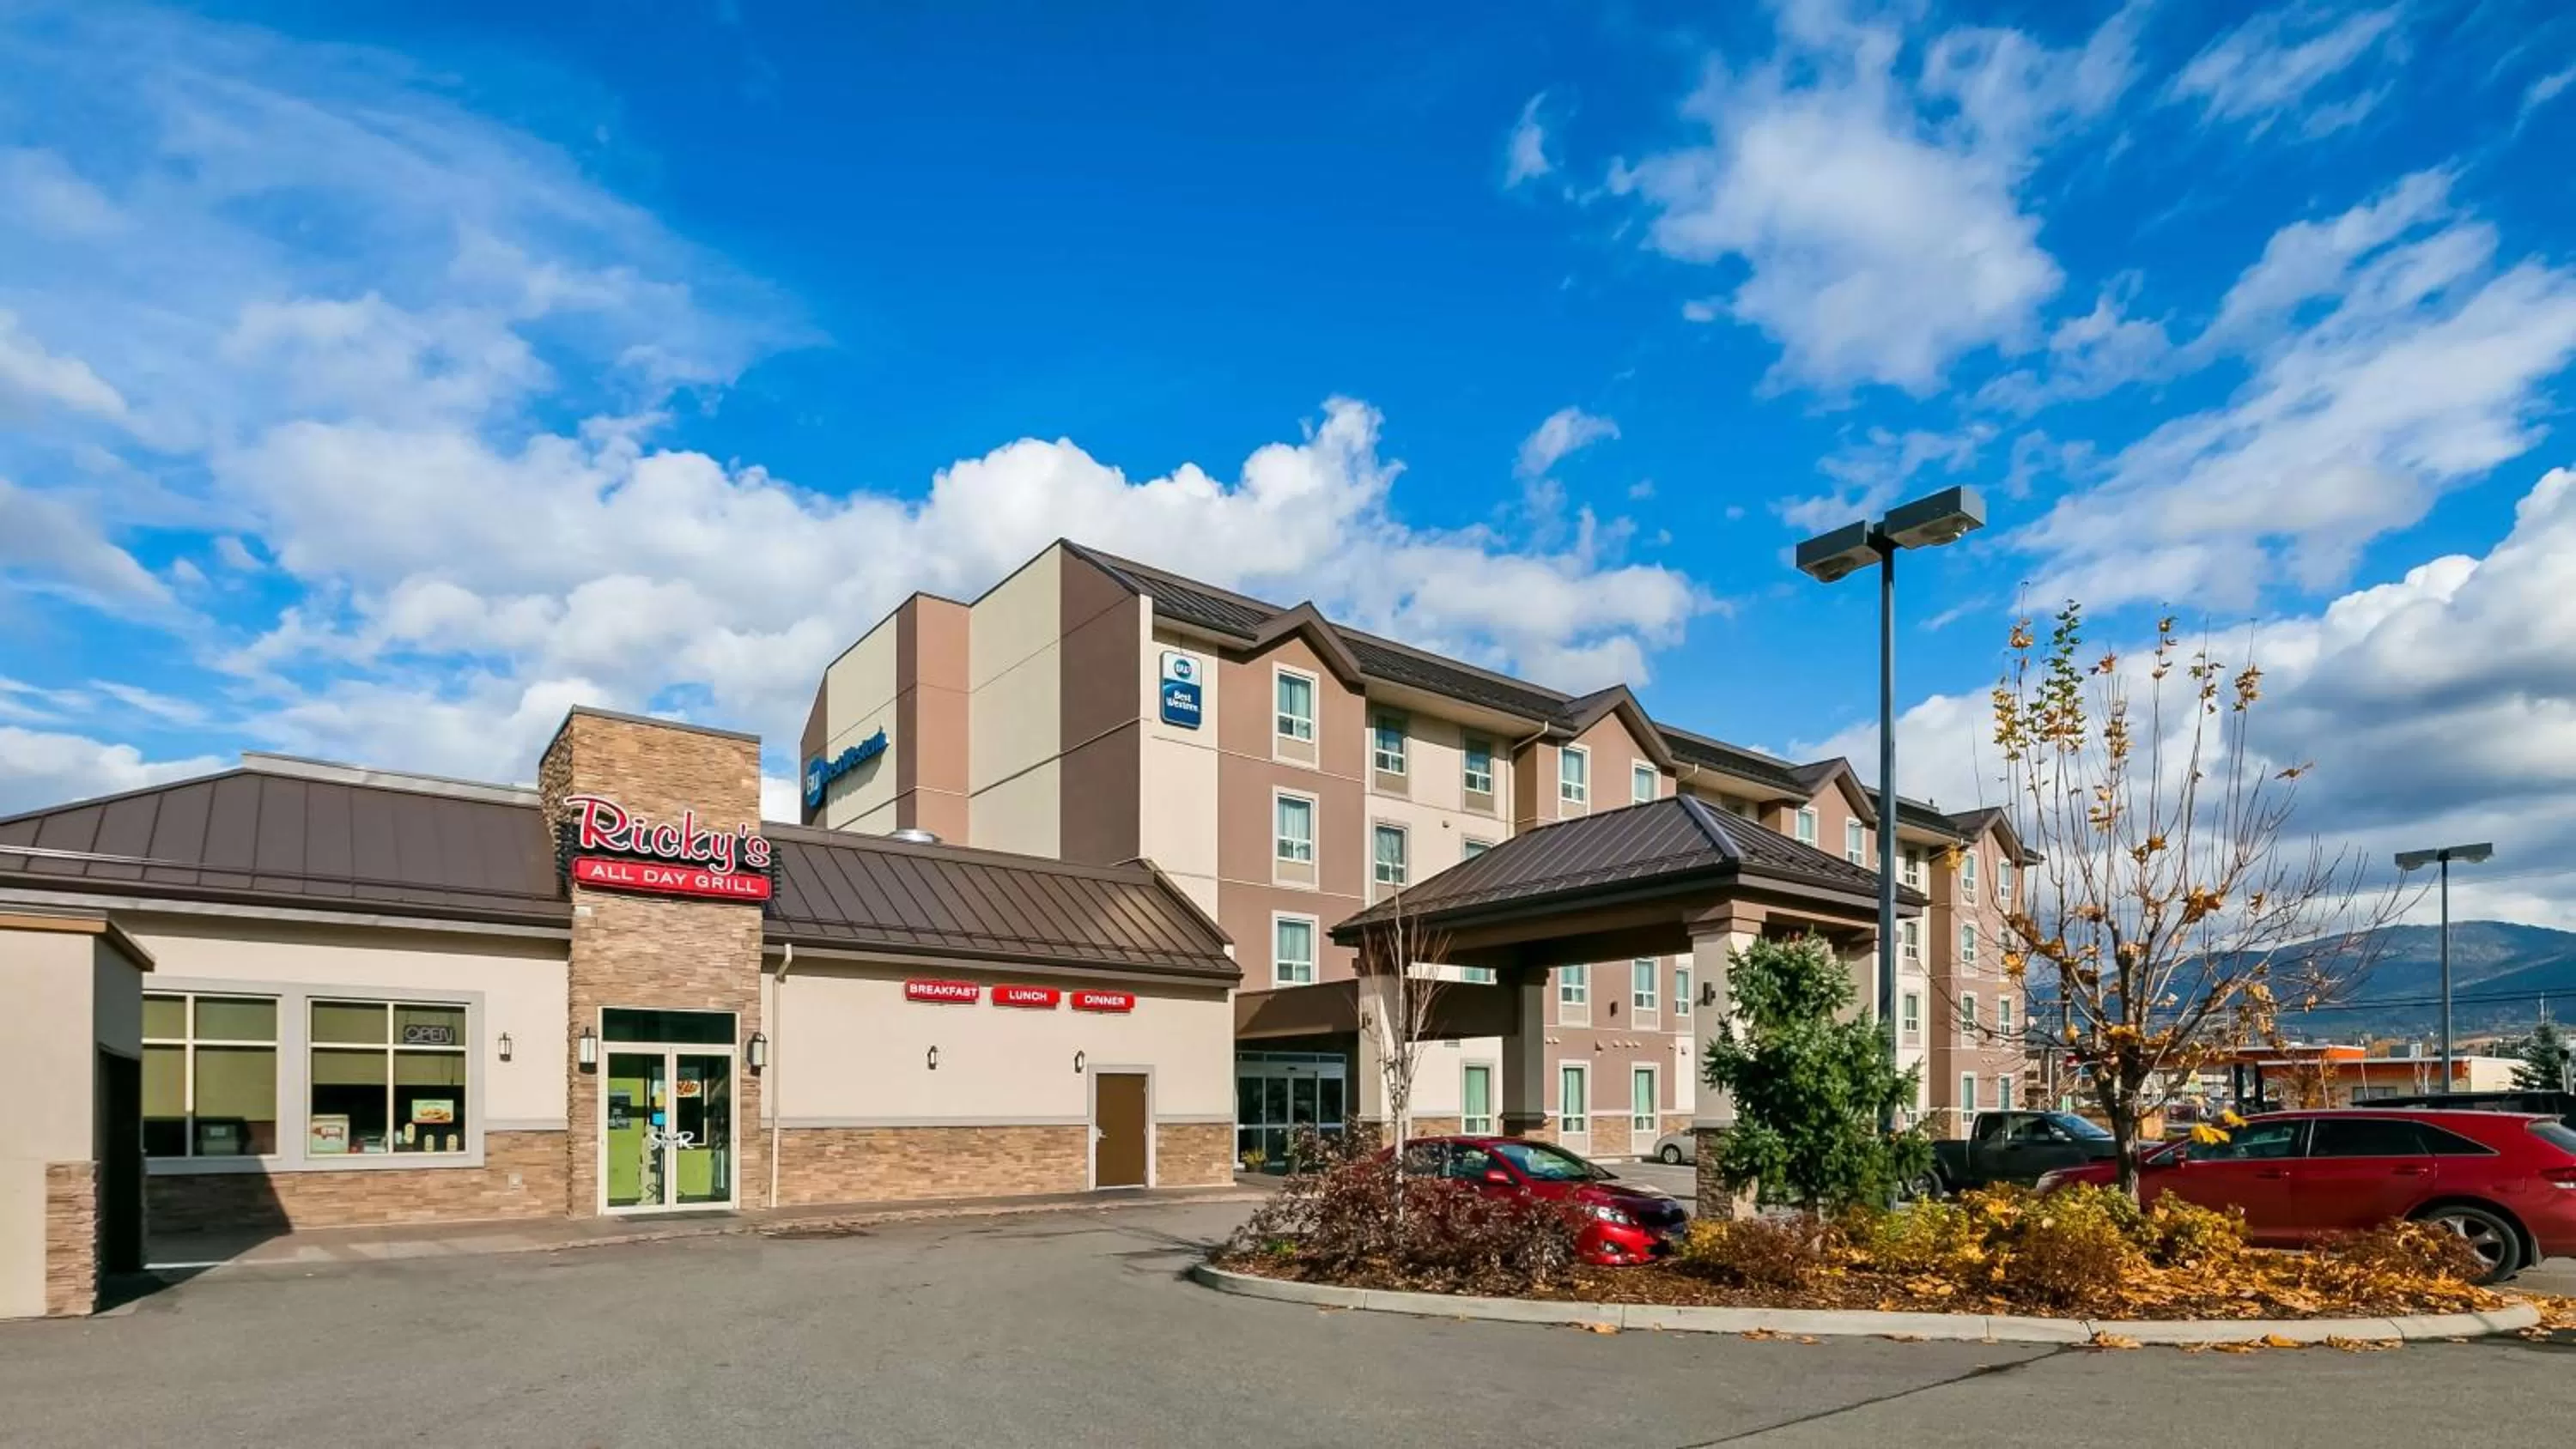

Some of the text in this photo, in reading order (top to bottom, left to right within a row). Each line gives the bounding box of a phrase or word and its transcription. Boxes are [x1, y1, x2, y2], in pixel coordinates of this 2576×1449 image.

[1174, 689, 1192, 702] Best
[1166, 697, 1199, 712] Western
[563, 794, 770, 875] Ricky's
[591, 864, 758, 894] ALL DAY GRILL
[909, 983, 978, 997] BREAKFAST
[1009, 990, 1048, 1001] LUNCH
[1084, 995, 1127, 1005] DINNER
[405, 1026, 453, 1041] OPEN
